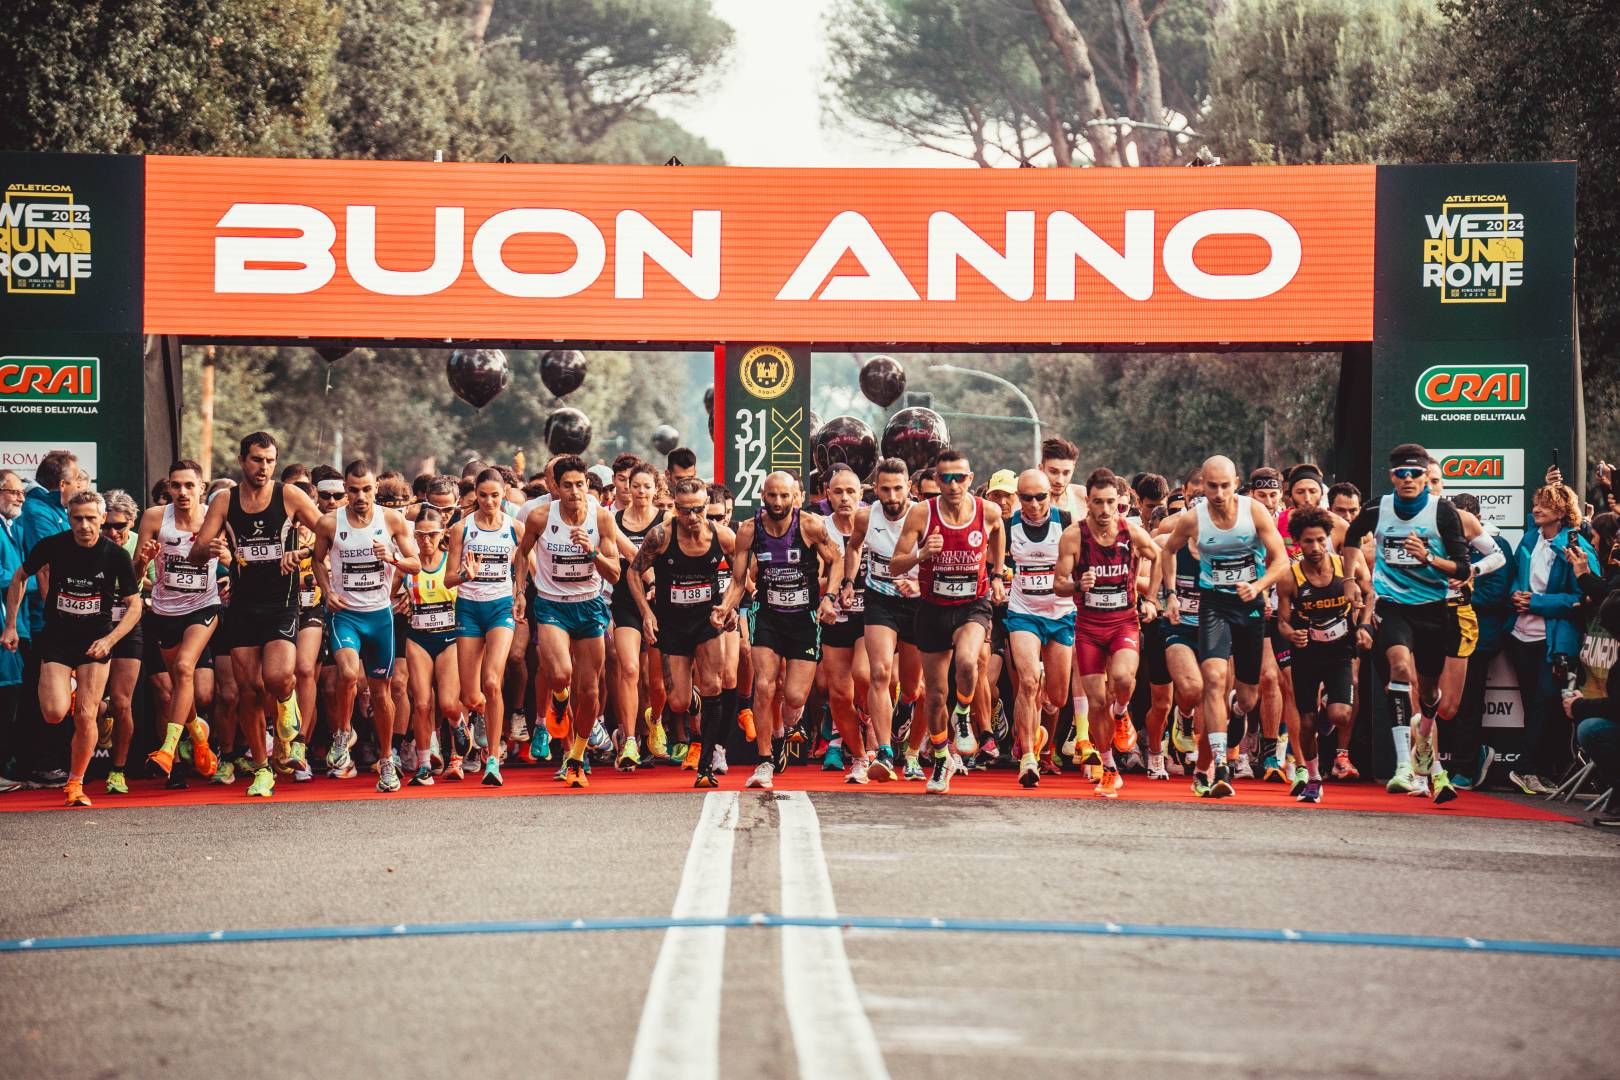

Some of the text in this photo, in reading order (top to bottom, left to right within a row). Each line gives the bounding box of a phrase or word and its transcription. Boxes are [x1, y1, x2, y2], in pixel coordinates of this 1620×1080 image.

[7, 183, 72, 192] ATLETICOM
[1445, 194, 1507, 202] ATLETICOM
[1424, 213, 1525, 238] WE
[214, 202, 1302, 301] BUON ANNO
[1423, 262, 1524, 288] ROME
[0, 364, 92, 394] CRAI
[1424, 372, 1521, 403] CRAI
[10, 405, 42, 413] CUORE
[44, 406, 98, 414] DELL'ITALIA
[1440, 413, 1472, 421] CUORE
[1473, 413, 1526, 421] DELL'ITALIA
[735, 408, 767, 446] 31
[735, 439, 767, 475] 12
[1442, 458, 1502, 477] CRAI
[251, 546, 268, 556] 80
[484, 564, 491, 572] 2
[1095, 563, 1129, 577] OLIZIA
[176, 573, 194, 585] 23
[360, 574, 367, 582] 4
[1030, 575, 1048, 585] 121
[1225, 569, 1242, 580] 27
[946, 583, 963, 592] 44
[682, 589, 701, 600] 138
[779, 592, 796, 602] 52
[1102, 594, 1109, 602] 3
[65, 599, 93, 610] 3483
[430, 614, 437, 622] 8
